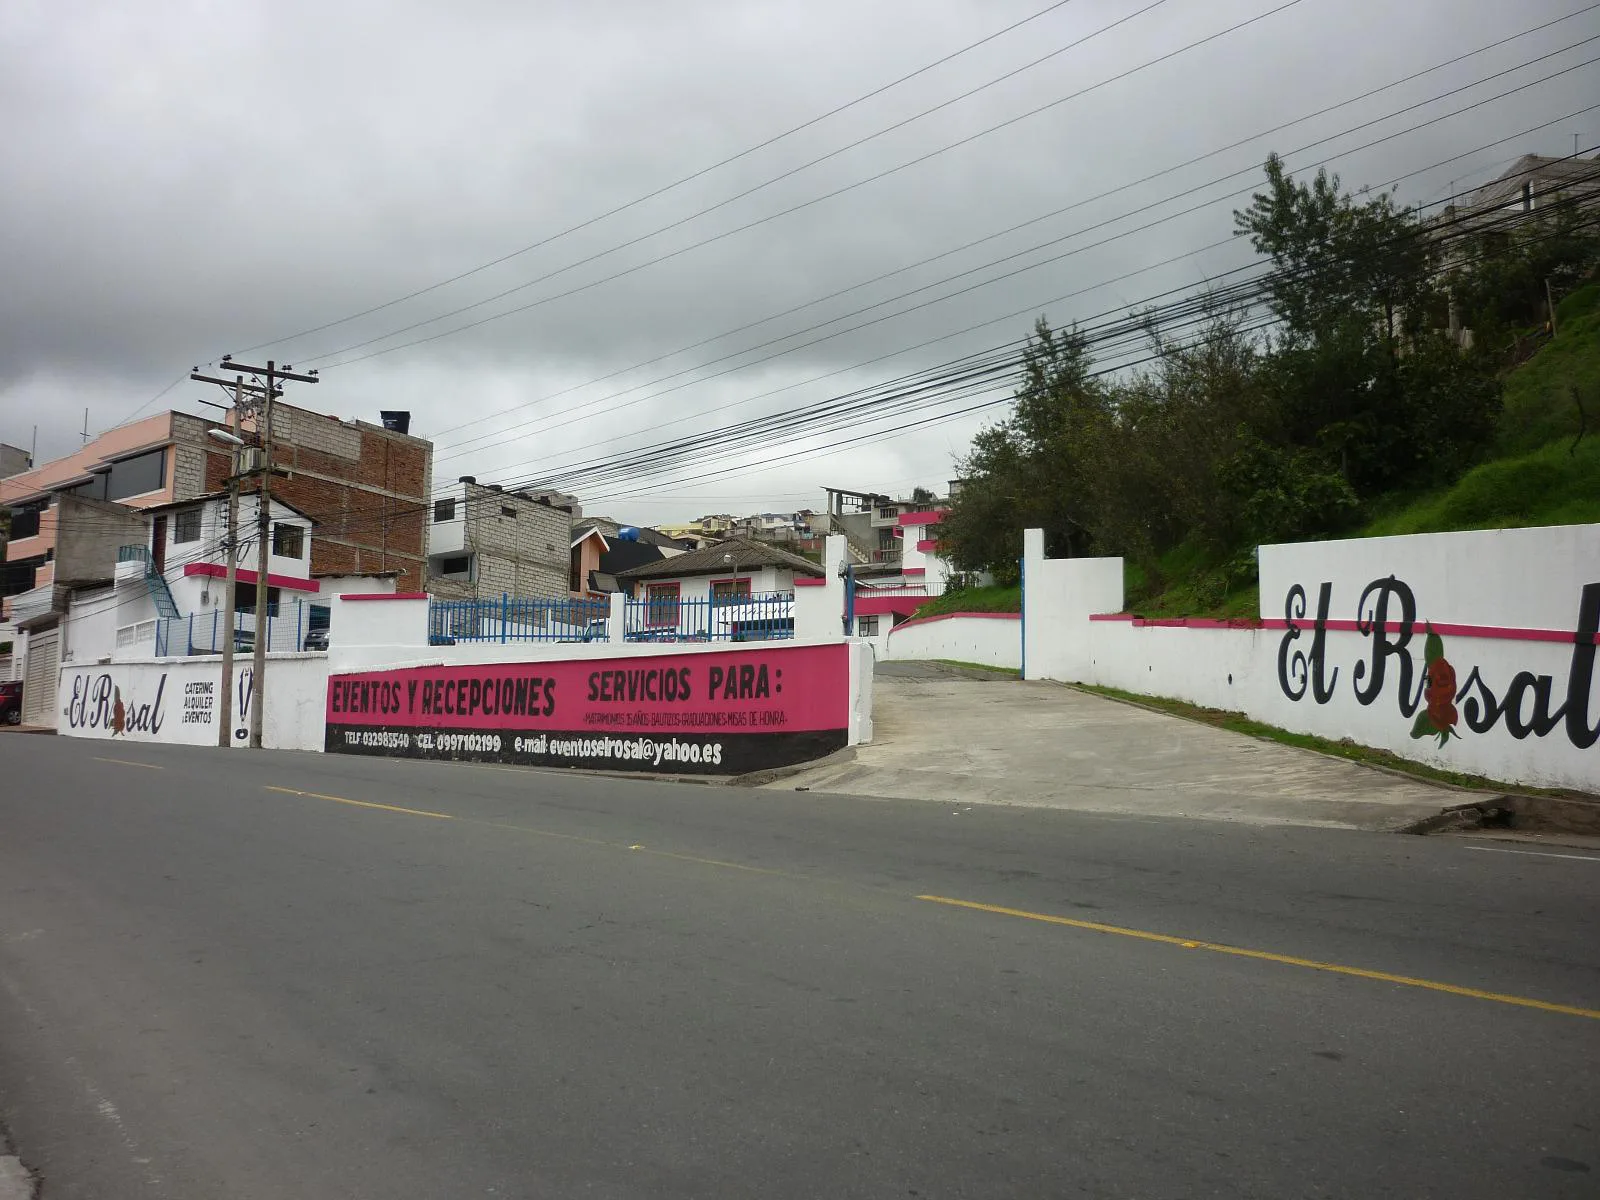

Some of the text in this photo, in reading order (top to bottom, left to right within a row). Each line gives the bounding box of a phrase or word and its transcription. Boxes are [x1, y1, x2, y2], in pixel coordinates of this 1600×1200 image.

[1278, 574, 1600, 749] El Rsal
[184, 681, 214, 695] CATERING
[332, 677, 556, 717] EVENTOS Y RECEPCIONES
[588, 663, 782, 702] SERVICIOS PARA:
[69, 673, 167, 736] El Rsal
[183, 696, 214, 711] ALQUILER
[549, 736, 722, 765] eventoselrosal@yahoo.es
